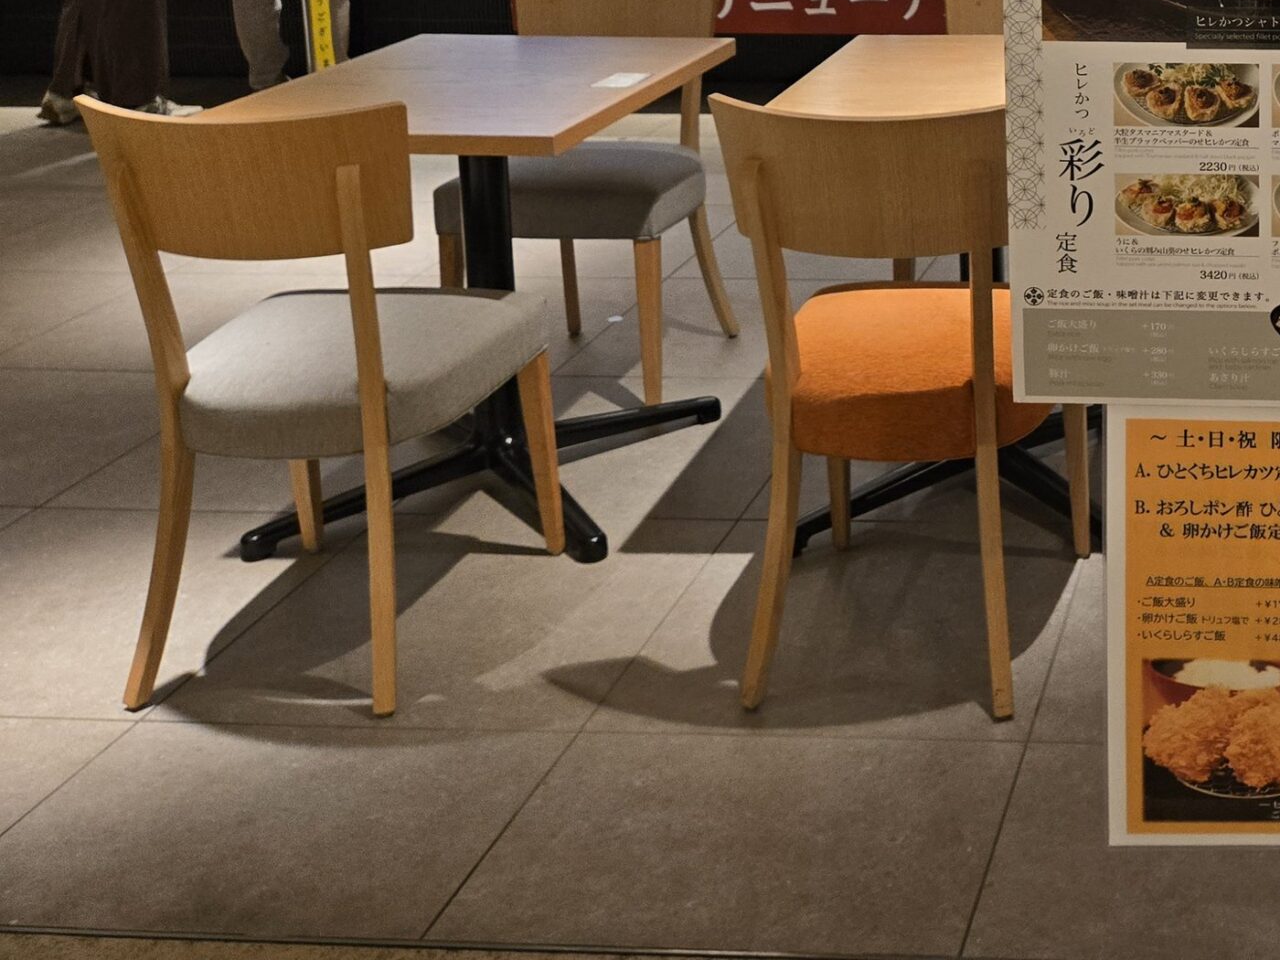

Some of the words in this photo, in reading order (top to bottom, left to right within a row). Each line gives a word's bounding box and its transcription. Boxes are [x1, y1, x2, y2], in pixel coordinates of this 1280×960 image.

[1075, 63, 1090, 119] ヒレかつ
[1059, 138, 1105, 227] 彩り
[1055, 232, 1078, 274] 定食
[1135, 465, 1150, 478] A.
[1135, 501, 1150, 515] B.
[1156, 500, 1253, 517] おろしポン酢
[1159, 525, 1174, 538] &
